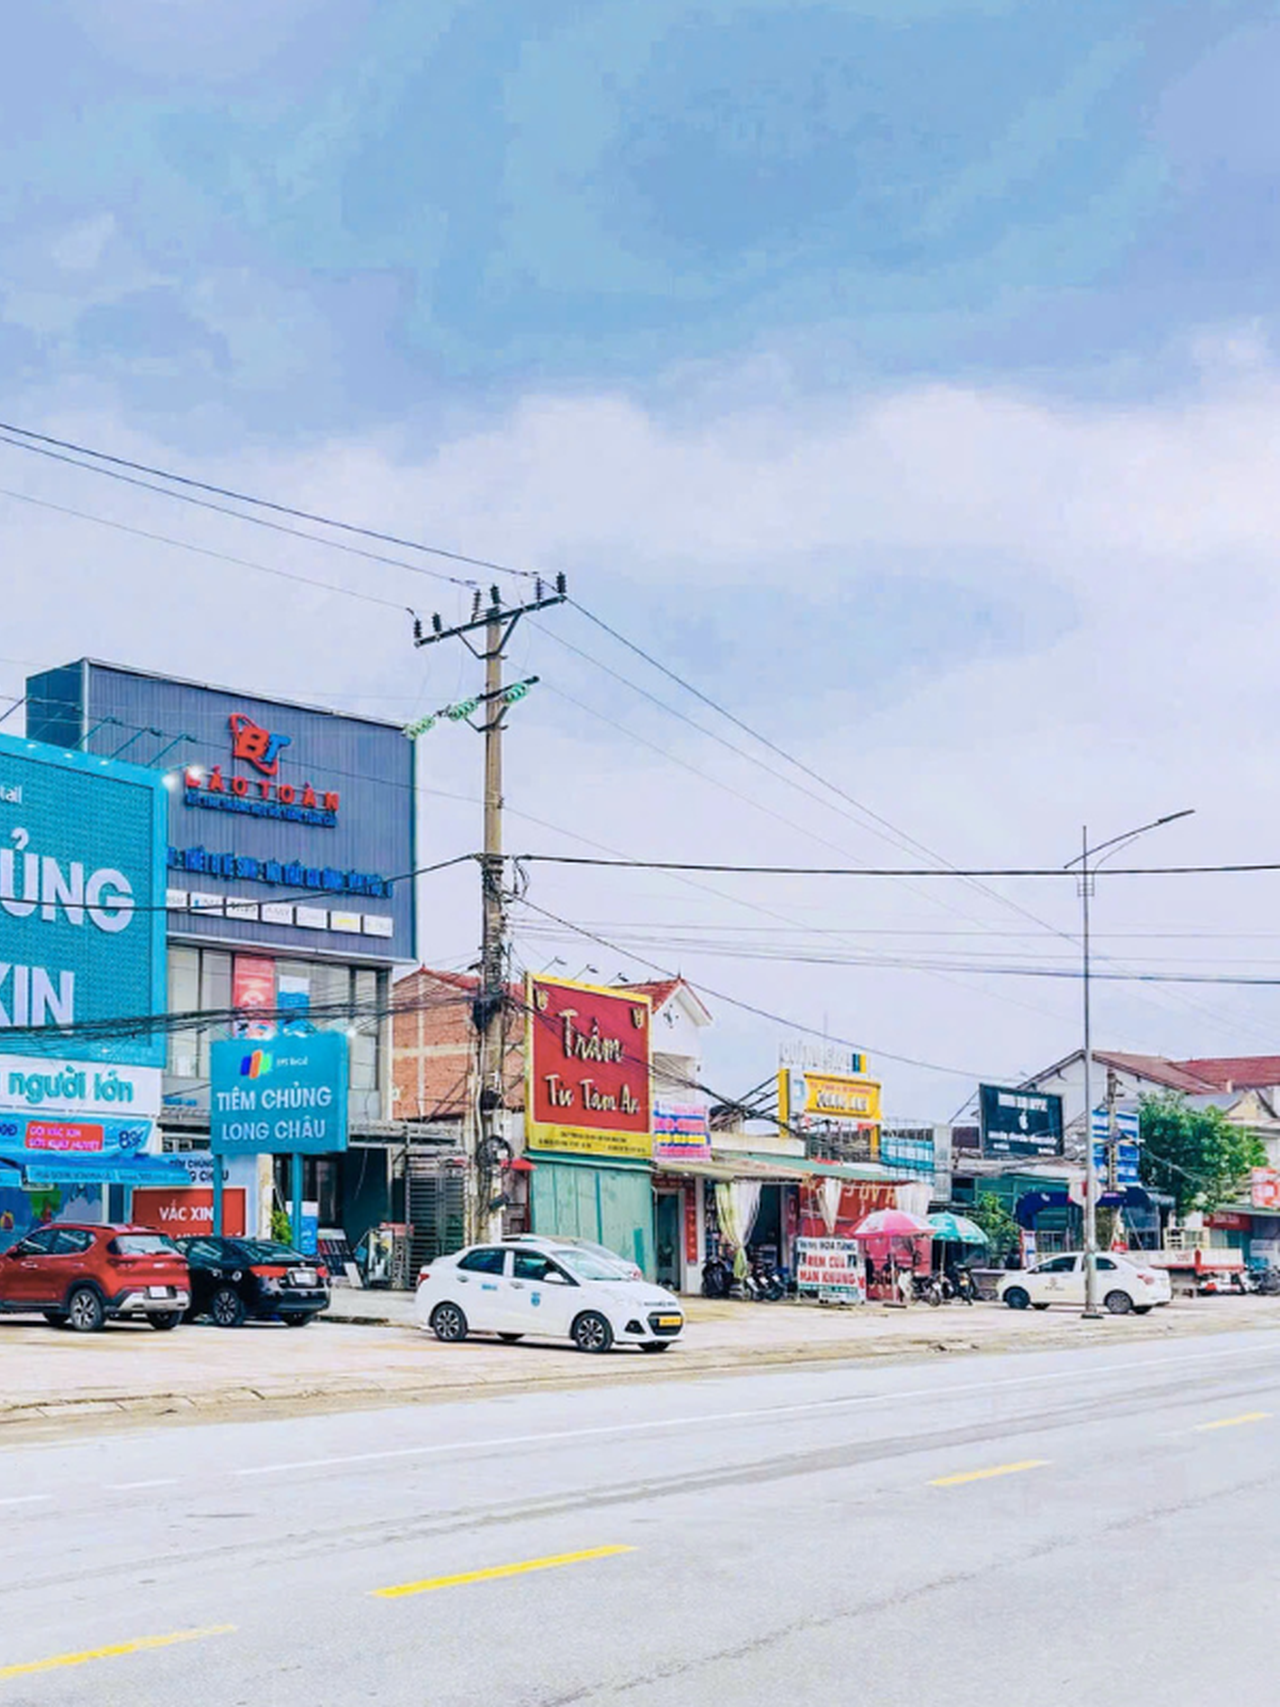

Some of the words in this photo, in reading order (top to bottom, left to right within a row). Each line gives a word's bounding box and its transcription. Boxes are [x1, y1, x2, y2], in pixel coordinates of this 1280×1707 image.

[7, 1065, 86, 1104] người
[93, 1070, 134, 1102] lớn
[217, 1086, 256, 1111] TIÊM
[261, 1081, 332, 1109] CHỦNG
[221, 1121, 270, 1141] LONG
[274, 1114, 326, 1139] CHÂU
[158, 1199, 187, 1221] VẮC
